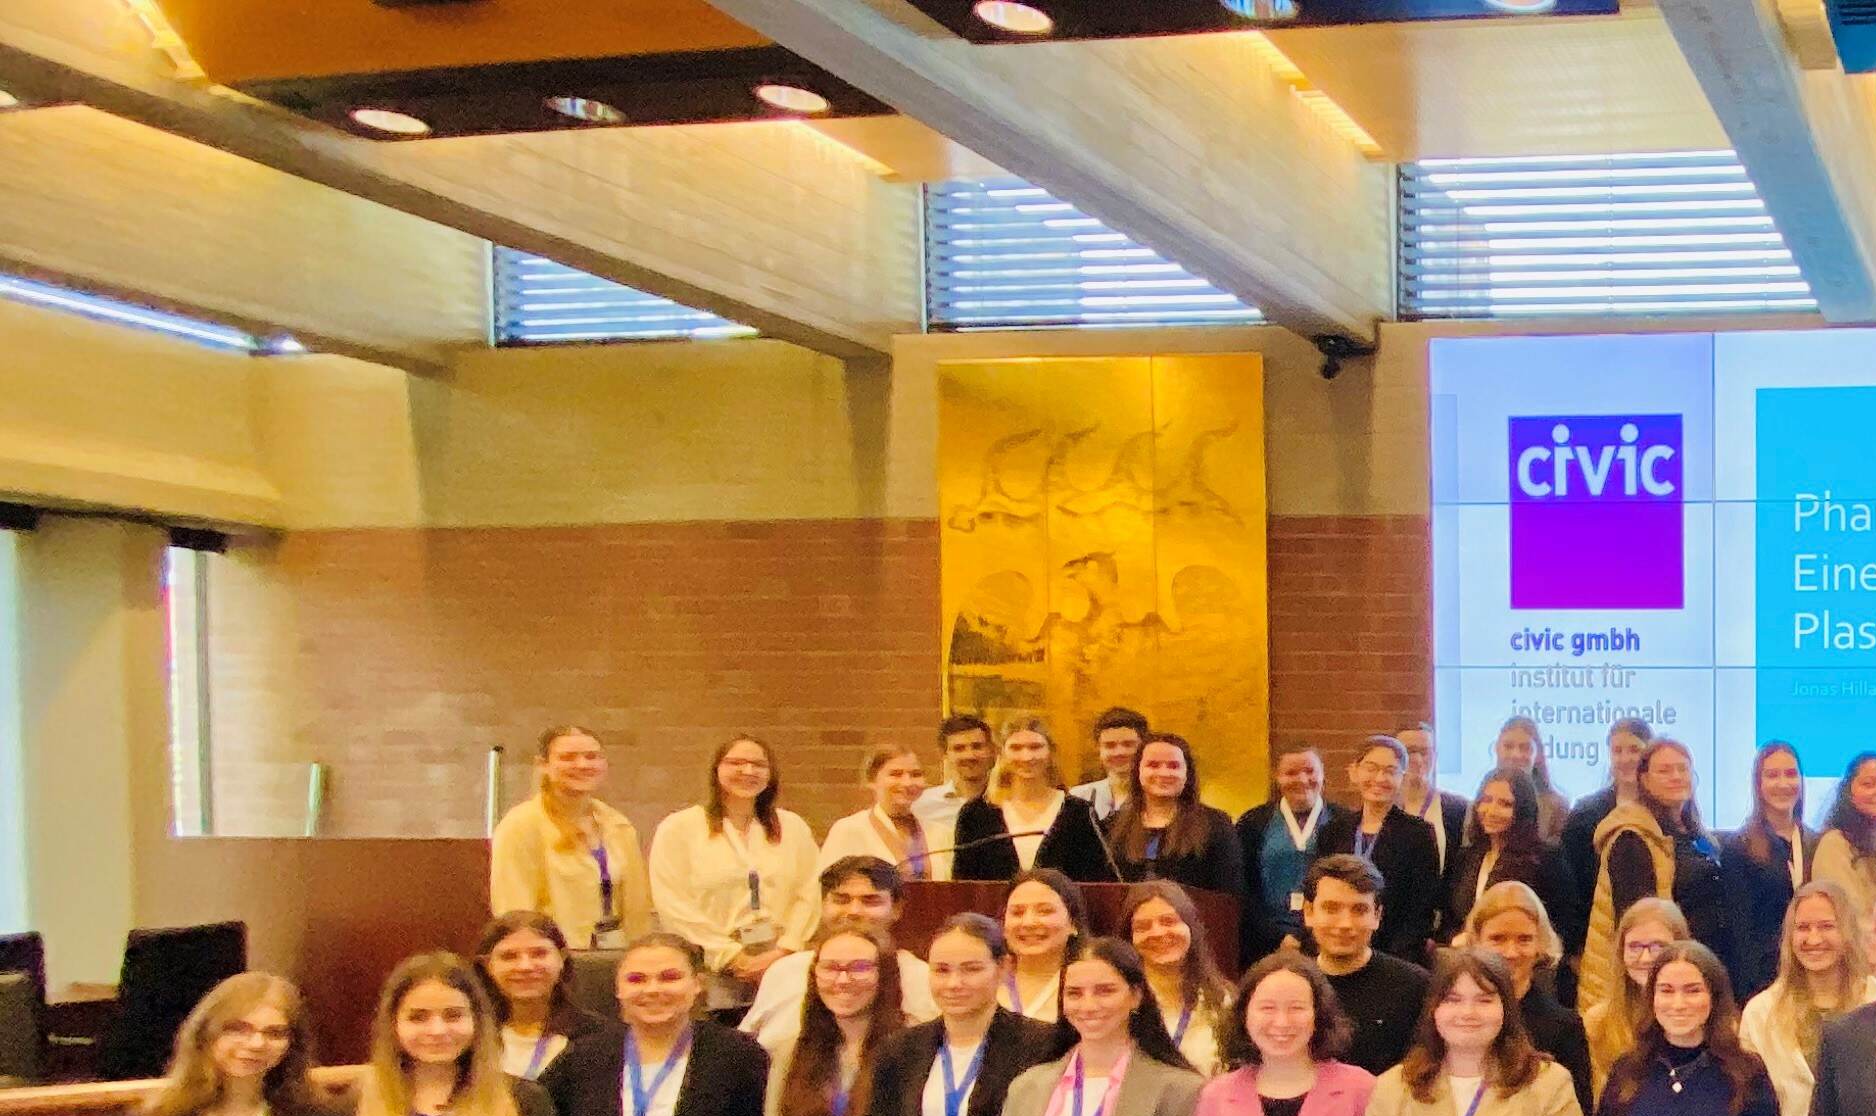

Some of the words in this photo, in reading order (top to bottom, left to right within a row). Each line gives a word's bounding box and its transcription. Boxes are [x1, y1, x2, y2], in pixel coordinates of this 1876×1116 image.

[1517, 423, 1675, 497] civic
[1510, 627, 1565, 652] civic
[1571, 627, 1641, 657] gmbh
[1510, 662, 1594, 689] institut
[1602, 661, 1637, 689] für
[1511, 699, 1678, 725] internationale
[1544, 735, 1599, 767] dung
